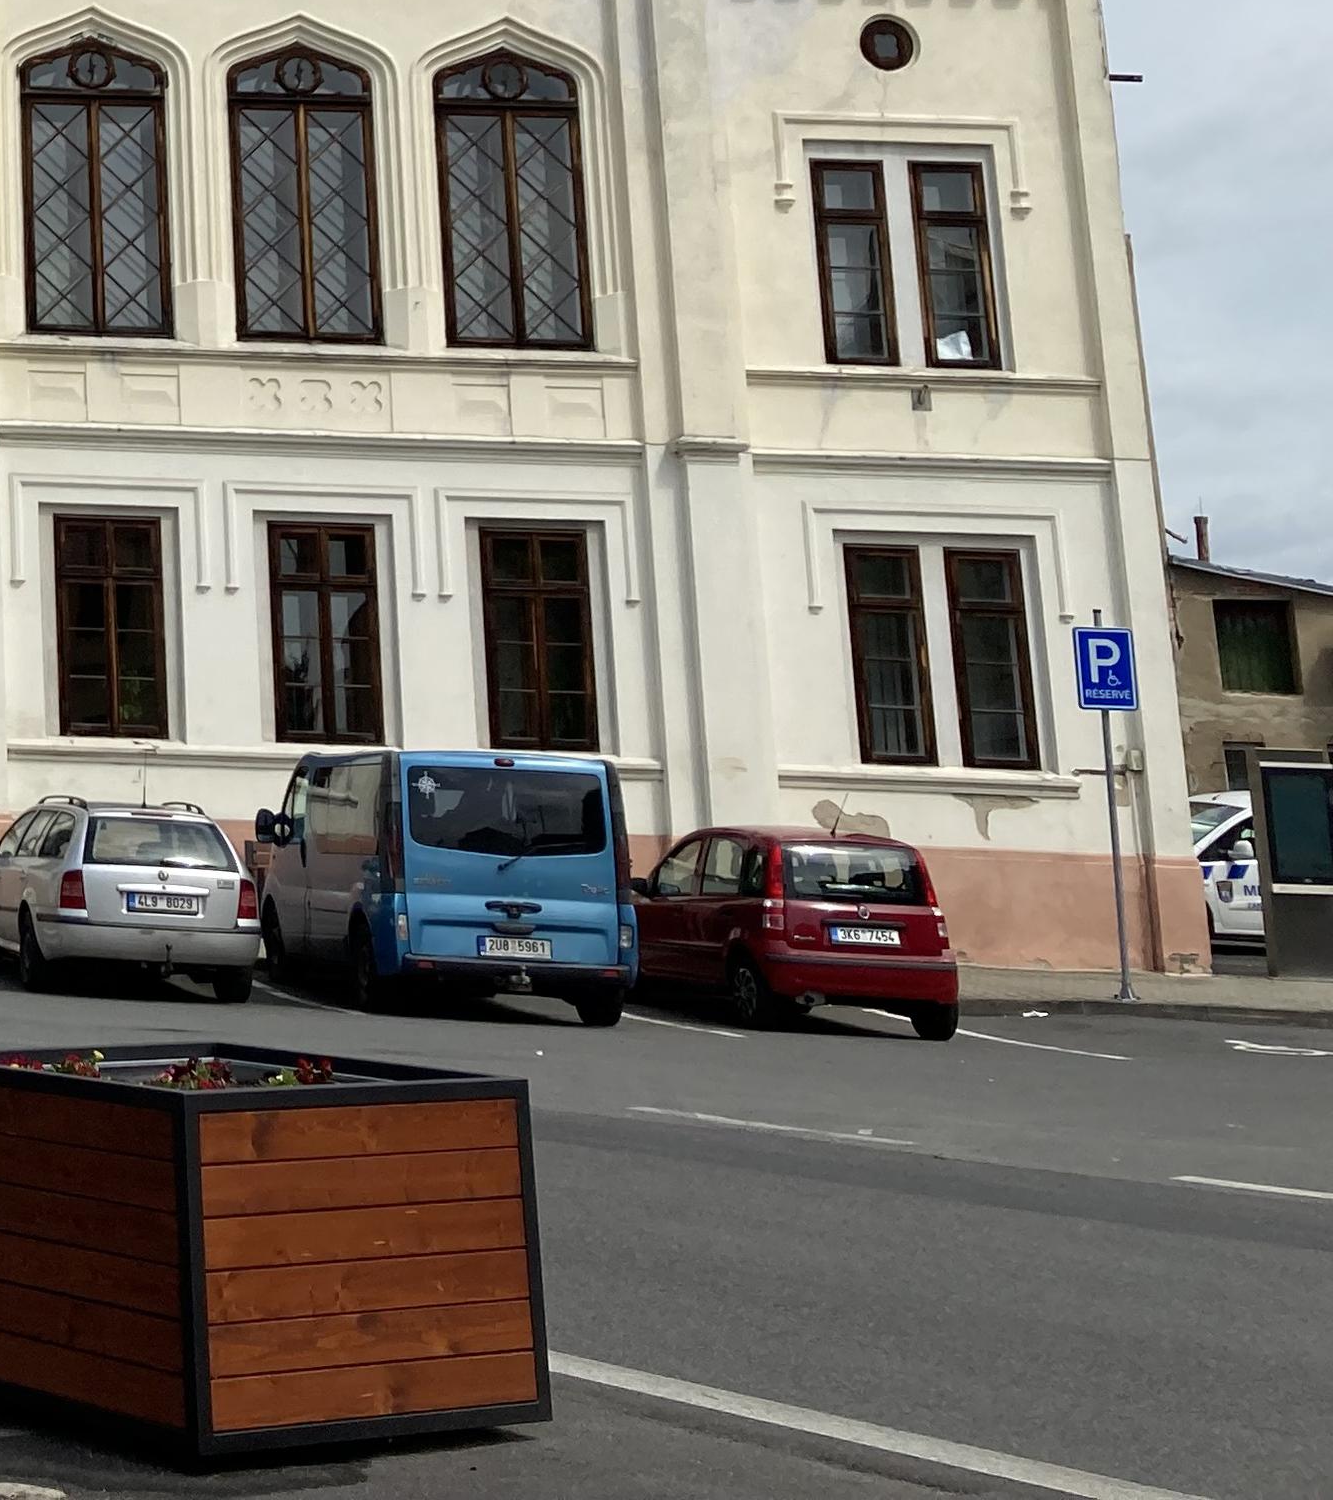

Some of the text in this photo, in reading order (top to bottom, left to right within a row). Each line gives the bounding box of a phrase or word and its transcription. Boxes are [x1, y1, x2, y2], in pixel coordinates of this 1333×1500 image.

[1087, 638, 1121, 683] P
[137, 895, 193, 909] 4L9 8029
[839, 928, 895, 942] 3K6 7454
[488, 939, 546, 954] 2U8 5961
